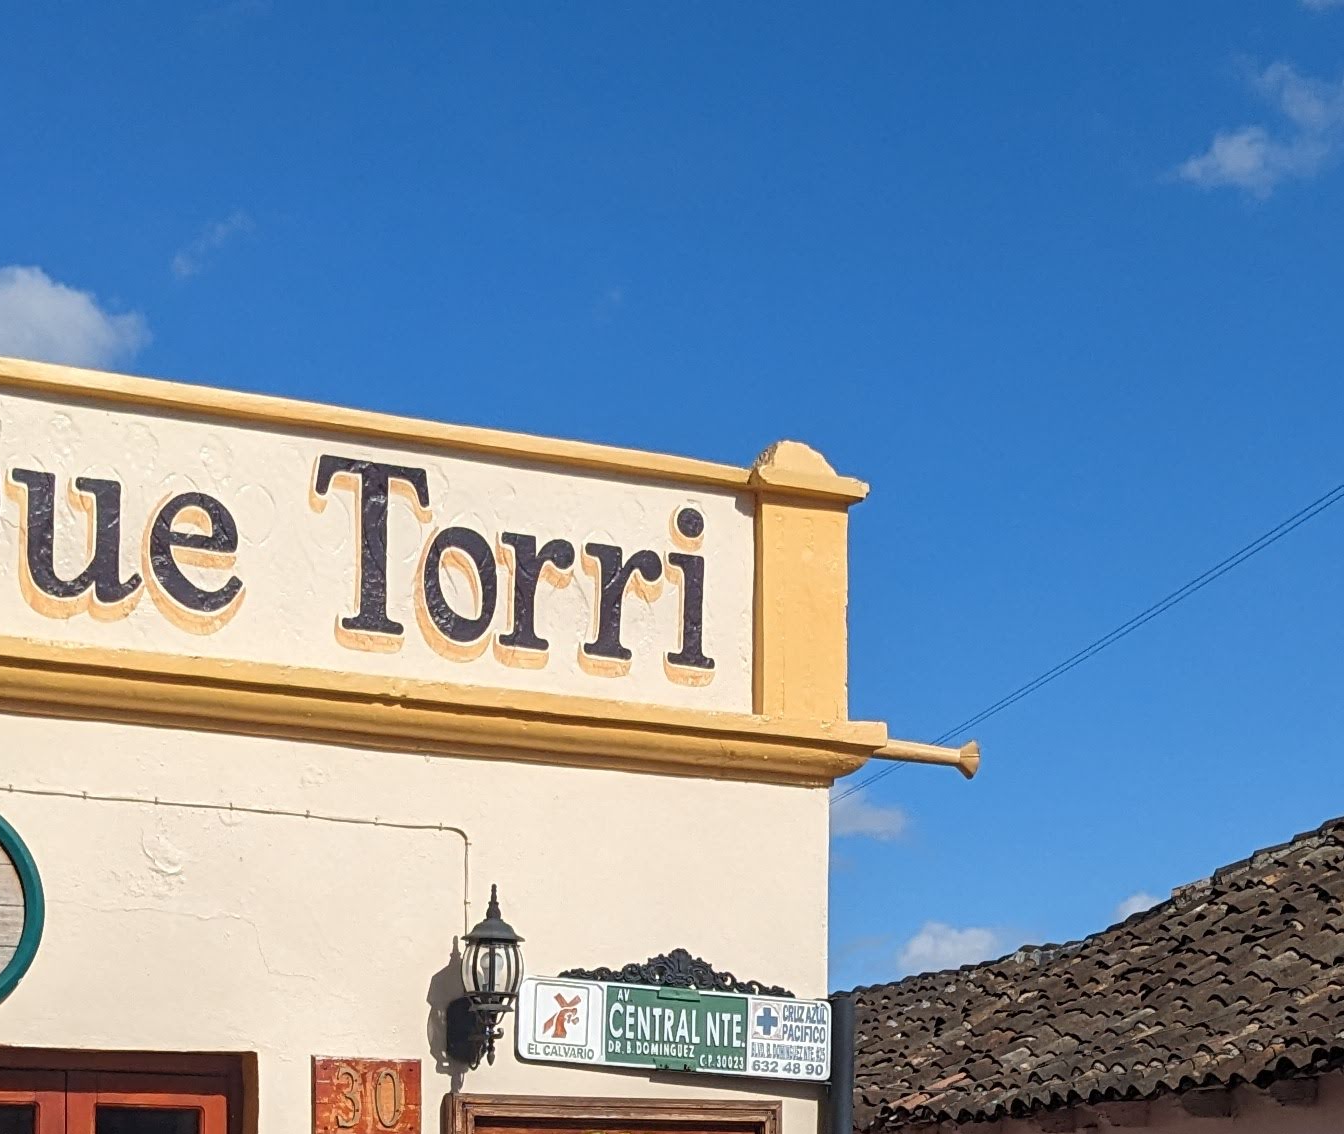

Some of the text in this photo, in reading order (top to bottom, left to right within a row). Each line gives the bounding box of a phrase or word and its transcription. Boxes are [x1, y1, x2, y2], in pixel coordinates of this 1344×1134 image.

[315, 454, 716, 670] Torri
[782, 1005, 805, 1024] CRUZ
[609, 1002, 746, 1048] CENTRAL NTE.
[782, 1024, 826, 1044] PACIFICO
[527, 1043, 595, 1060] EL CALVARIO
[636, 1041, 695, 1058] DOMINGUEZ
[716, 1056, 744, 1070] 30023
[751, 1060, 824, 1076] 632 48 90
